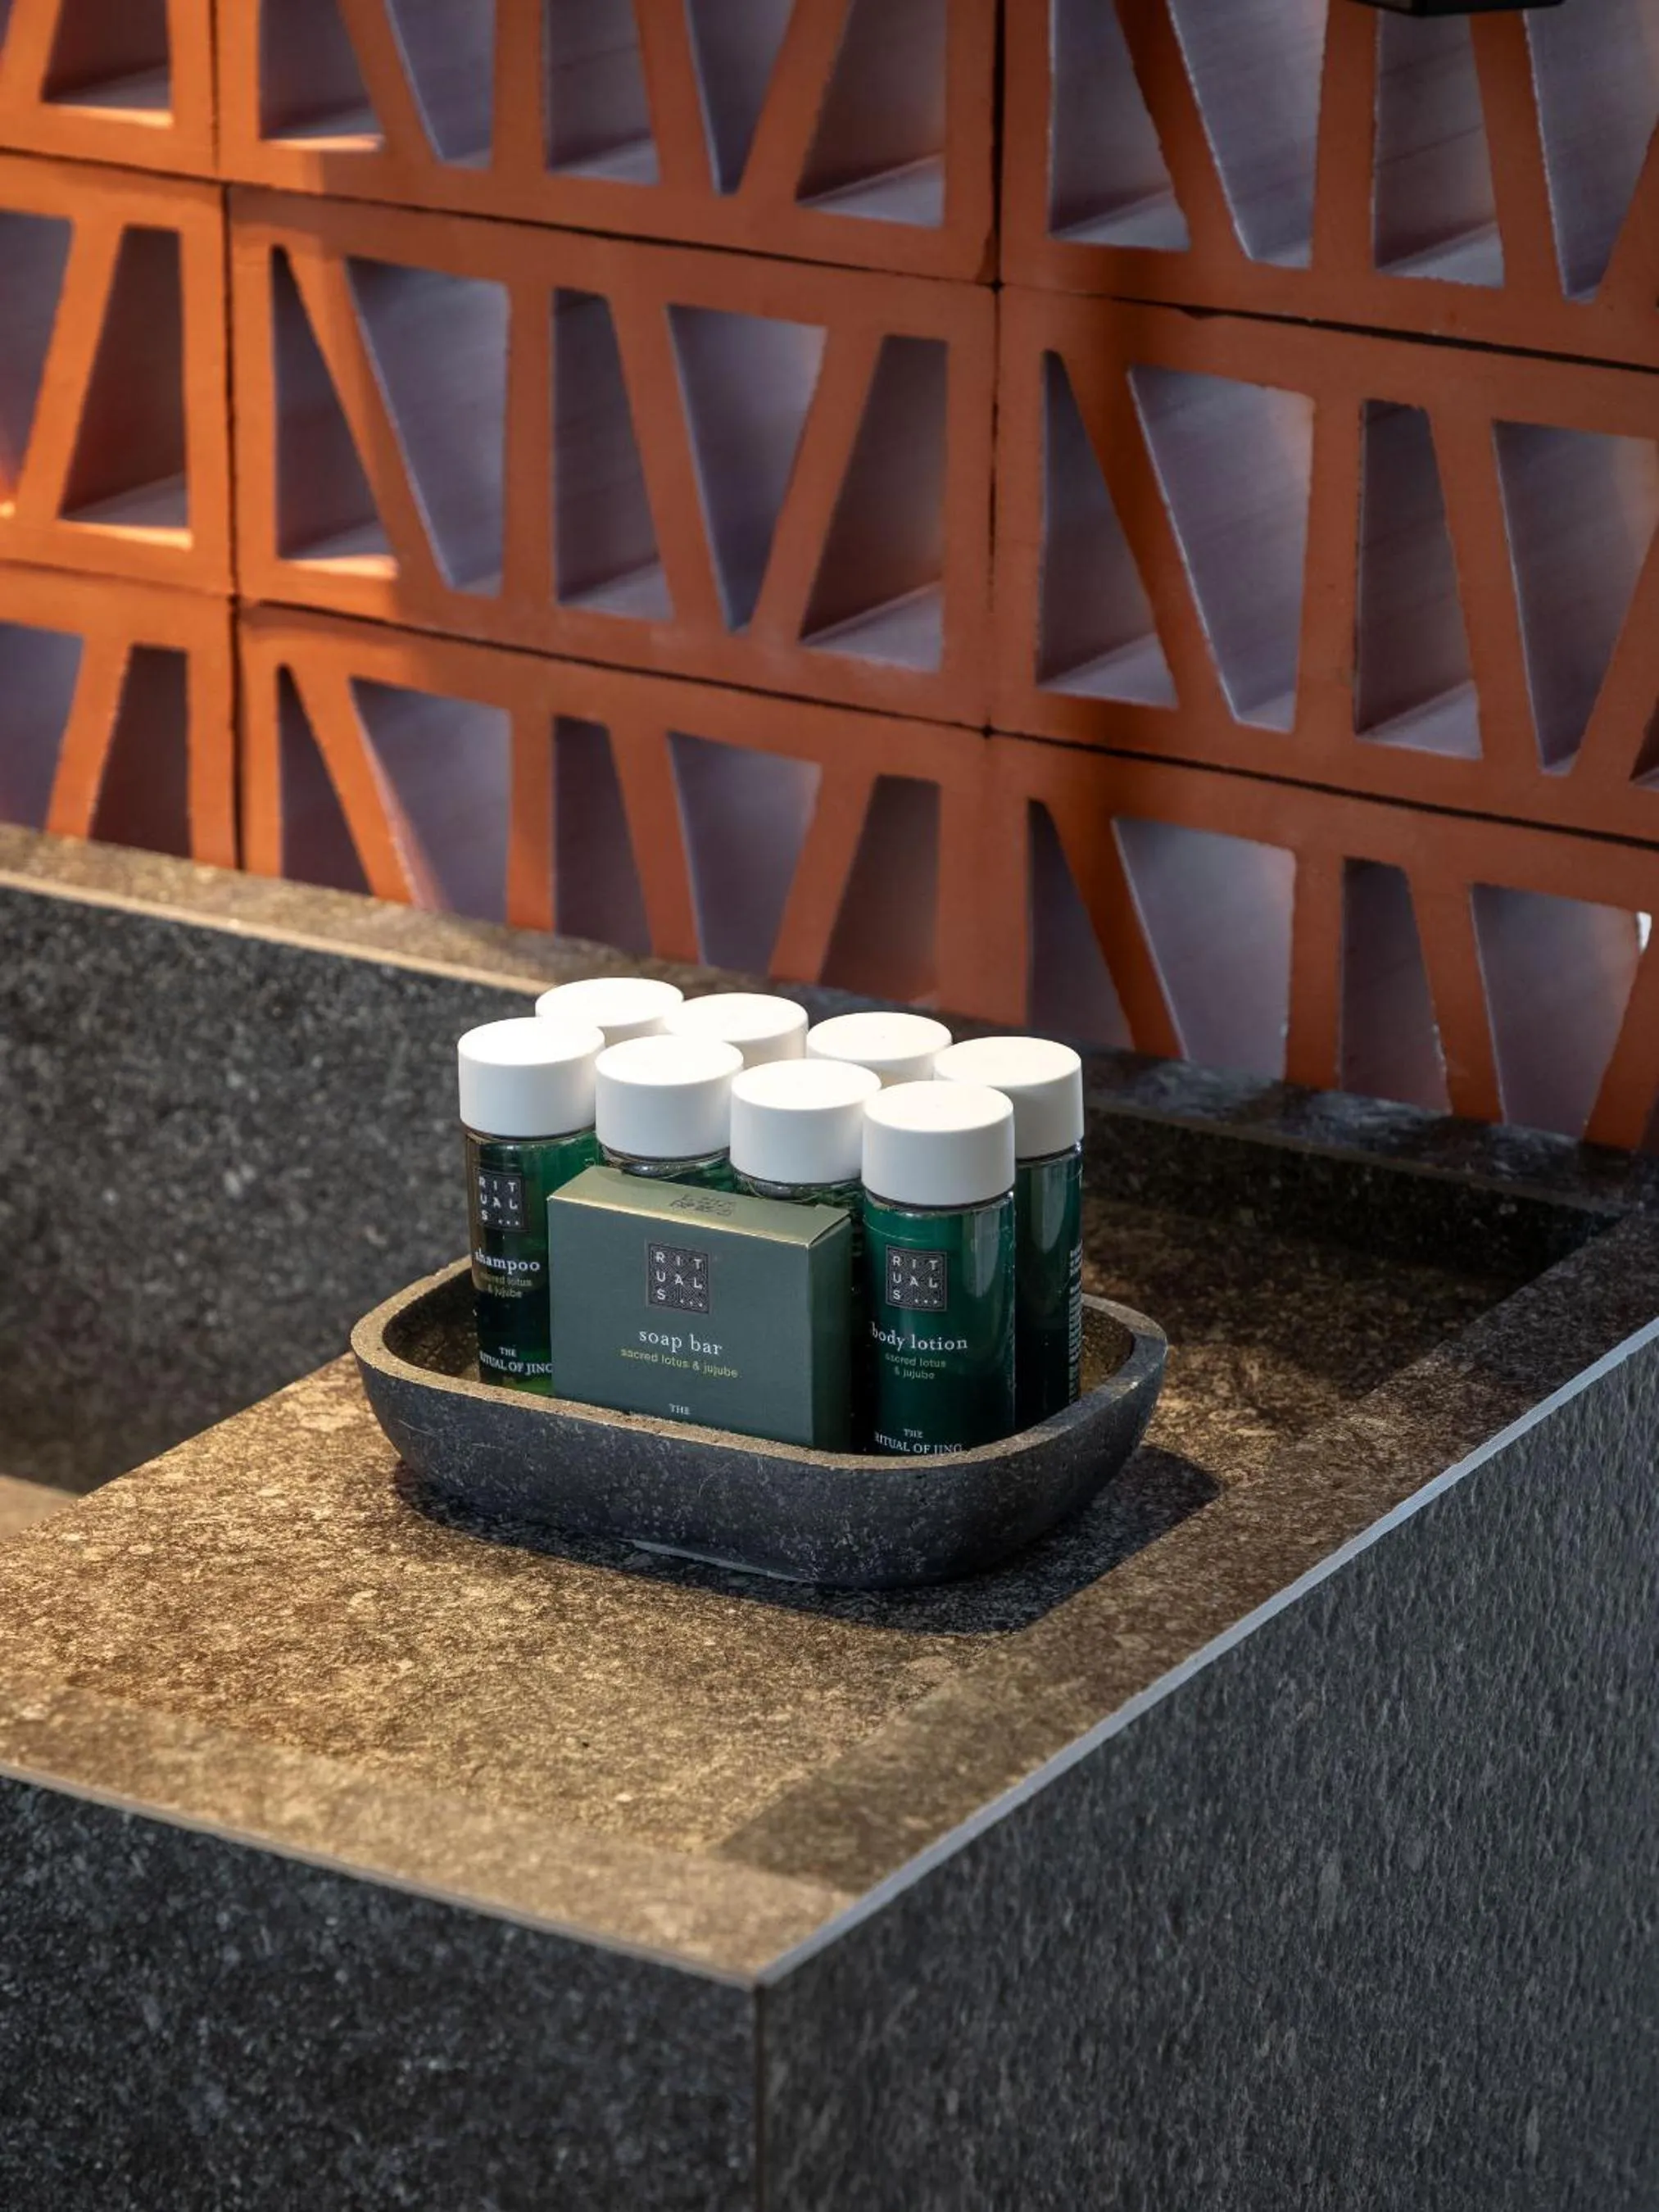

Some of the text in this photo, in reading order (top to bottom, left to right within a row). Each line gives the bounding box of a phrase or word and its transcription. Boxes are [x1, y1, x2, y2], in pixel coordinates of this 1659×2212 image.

[639, 1330, 723, 1355] soap bar
[871, 1321, 968, 1351] body lotion
[498, 1346, 518, 1358] THE
[620, 1348, 738, 1378] sacred lotus & jujube
[919, 1358, 947, 1368] lotus
[669, 1403, 691, 1416] THE
[913, 1443, 931, 1454] OF
